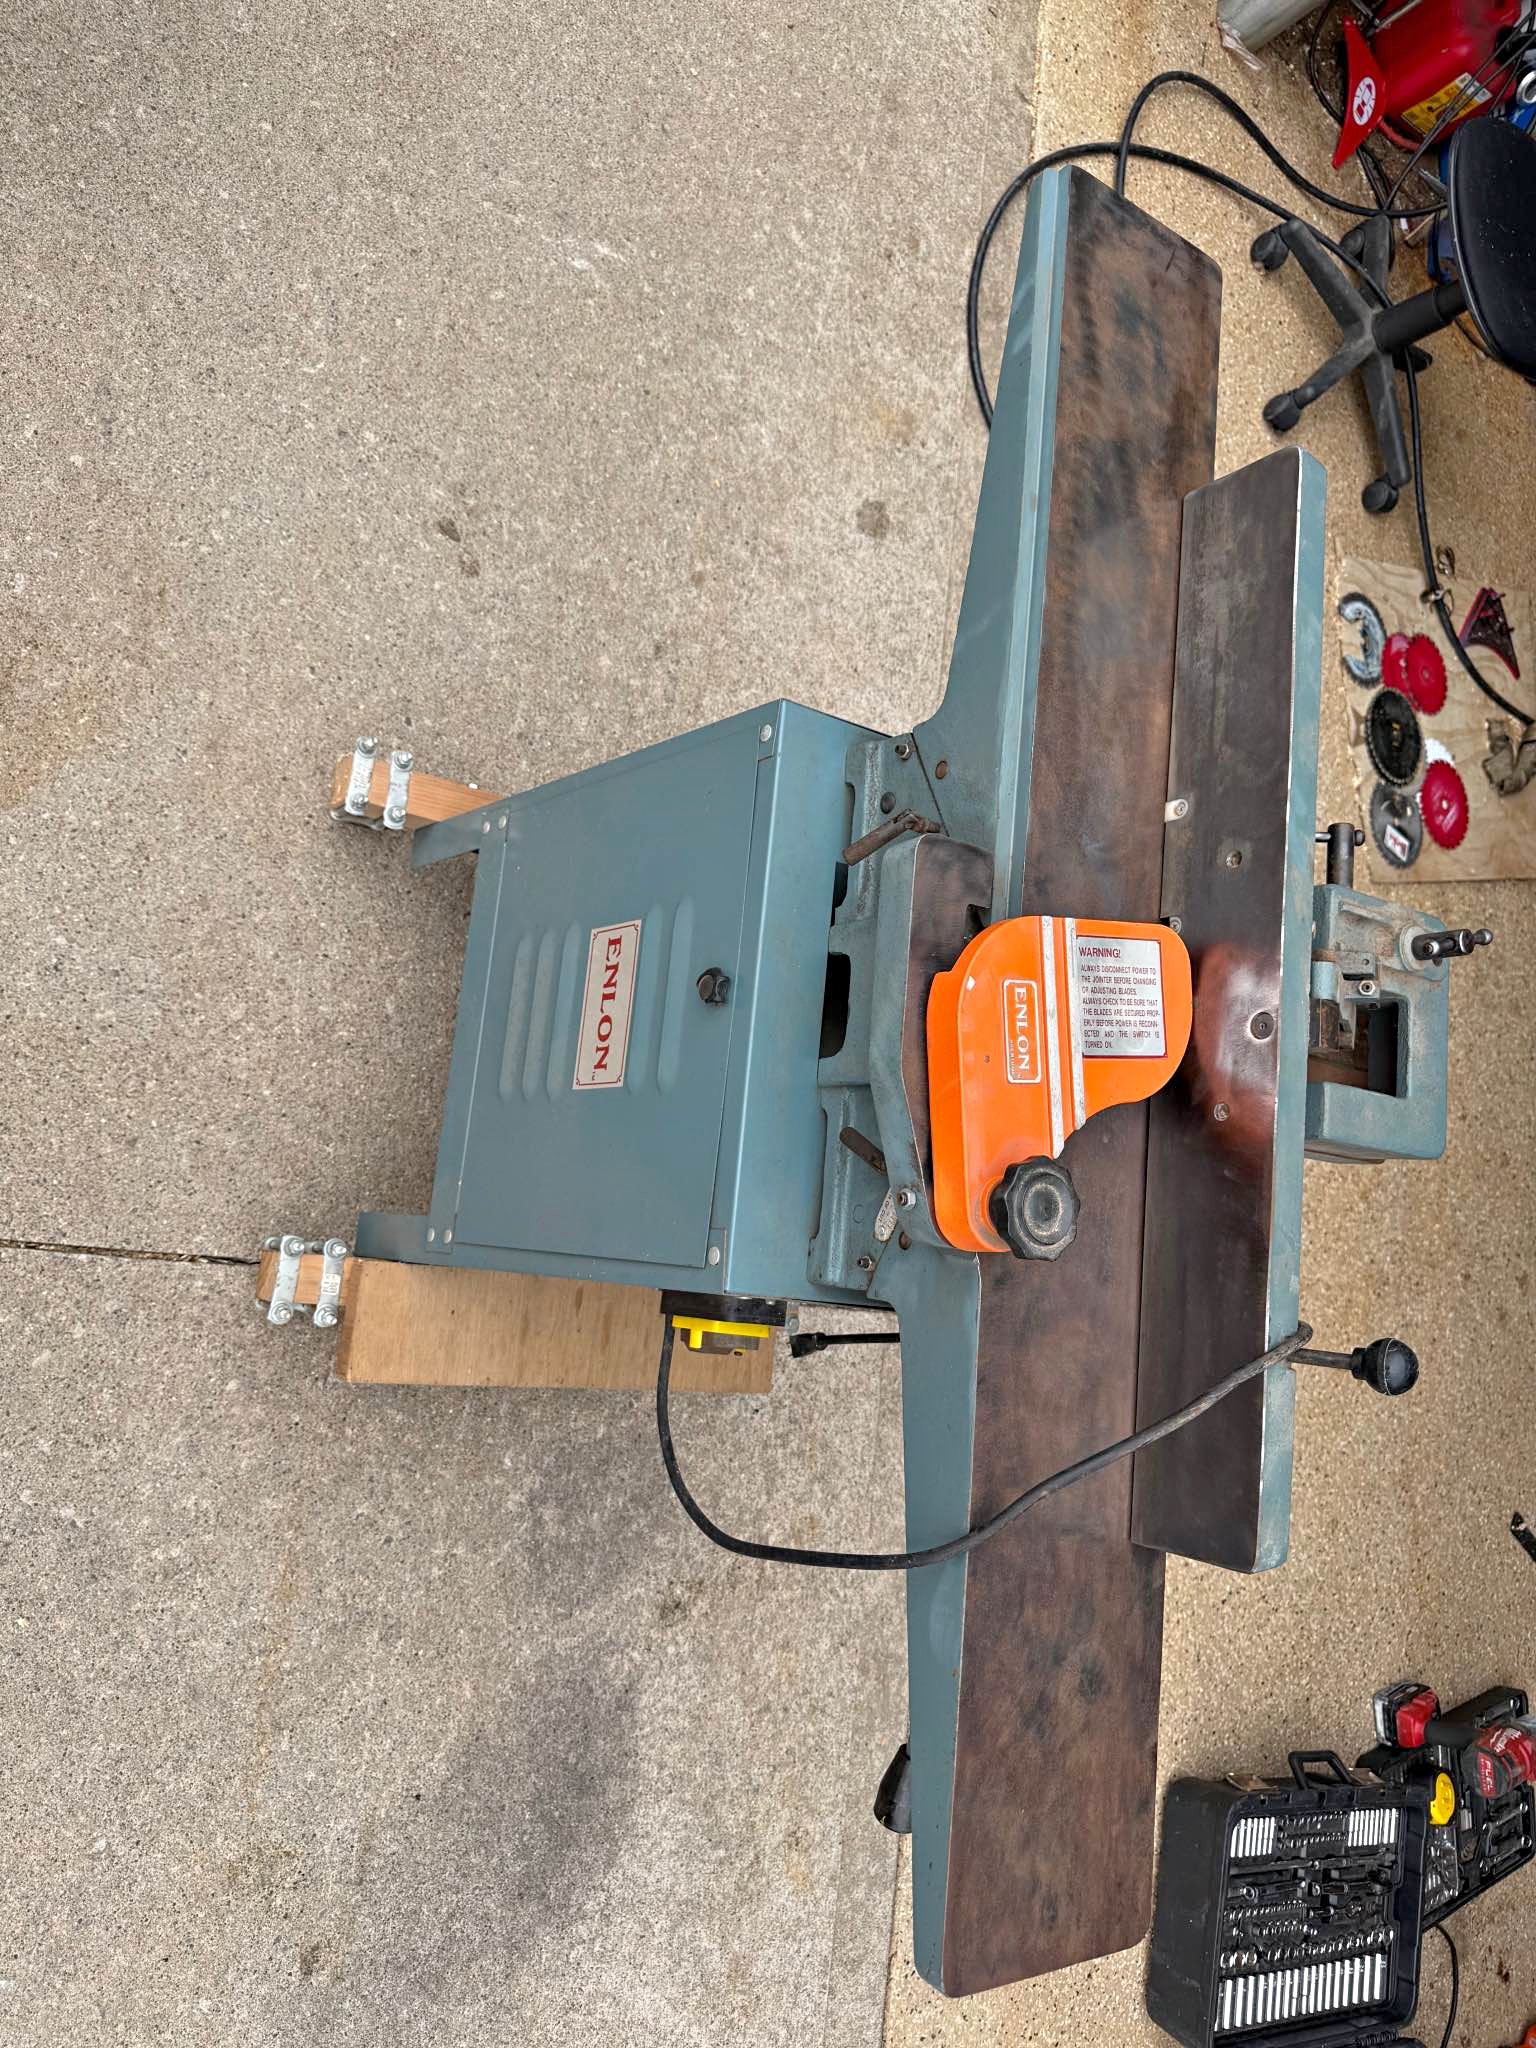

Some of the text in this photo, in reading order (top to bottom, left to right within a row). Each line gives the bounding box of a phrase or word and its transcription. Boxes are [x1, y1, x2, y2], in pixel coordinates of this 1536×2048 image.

[1079, 947, 1121, 959] WARNING!
[1081, 964, 1157, 975] ALWAYS DISCONNECT POWER TO
[1081, 975, 1157, 986] THE JOINTER BEFORE CHANGING
[1082, 986, 1089, 994] OR
[1091, 986, 1117, 995] ADJUSTING
[594, 936, 622, 1070] ENLON
[1082, 997, 1102, 1006] ALWAYS
[1103, 998, 1119, 1006] CHECK
[1120, 998, 1126, 1006] TO
[1134, 999, 1146, 1007] SURE
[1147, 999, 1158, 1007] THAT
[1083, 1008, 1093, 1016] THE
[1094, 1008, 1112, 1016] BLADES
[1114, 1009, 1124, 1017] ARE
[1125, 1009, 1146, 1017] SECURED
[1084, 1018, 1095, 1027] ERLY
[1096, 1019, 1114, 1027] BEFORE
[1115, 1019, 1132, 1027] POWER
[1133, 1020, 1138, 1028] IS
[1015, 987, 1030, 1070] ENLON
[1084, 1029, 1160, 1039] ECTED AND THE SWITCH IS
[1085, 1040, 1103, 1049] TURNED
